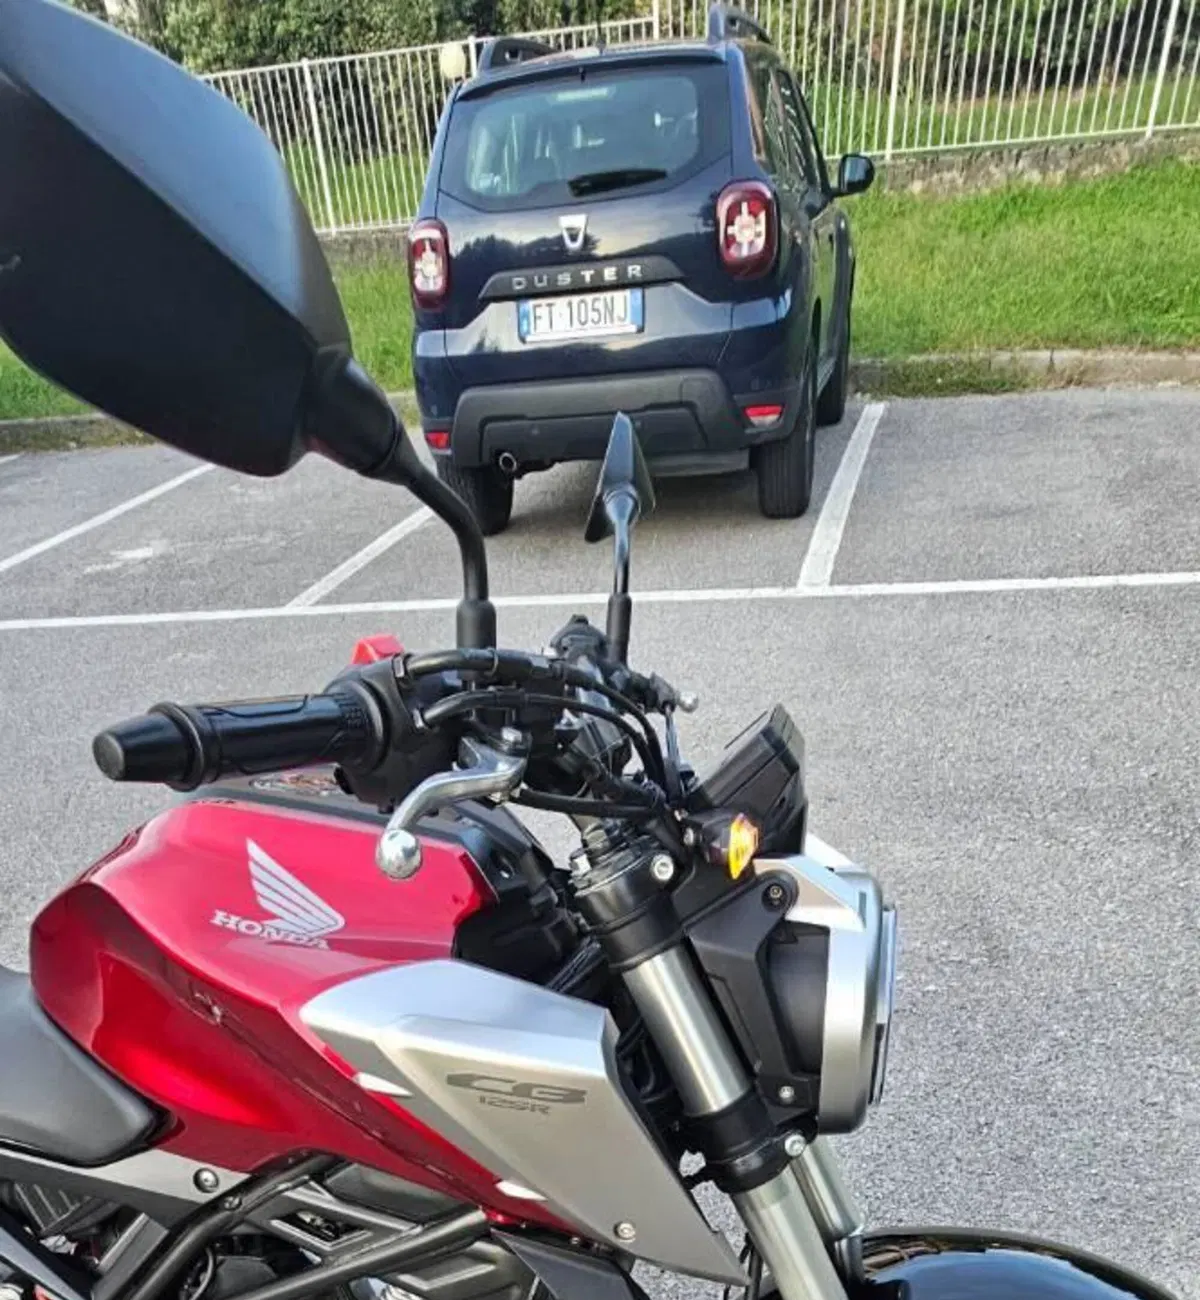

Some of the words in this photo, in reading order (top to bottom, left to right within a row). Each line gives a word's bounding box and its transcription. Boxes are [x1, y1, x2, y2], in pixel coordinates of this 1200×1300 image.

[512, 265, 642, 290] DUSTER
[210, 909, 330, 951] HONDA
[446, 1074, 587, 1103] CB
